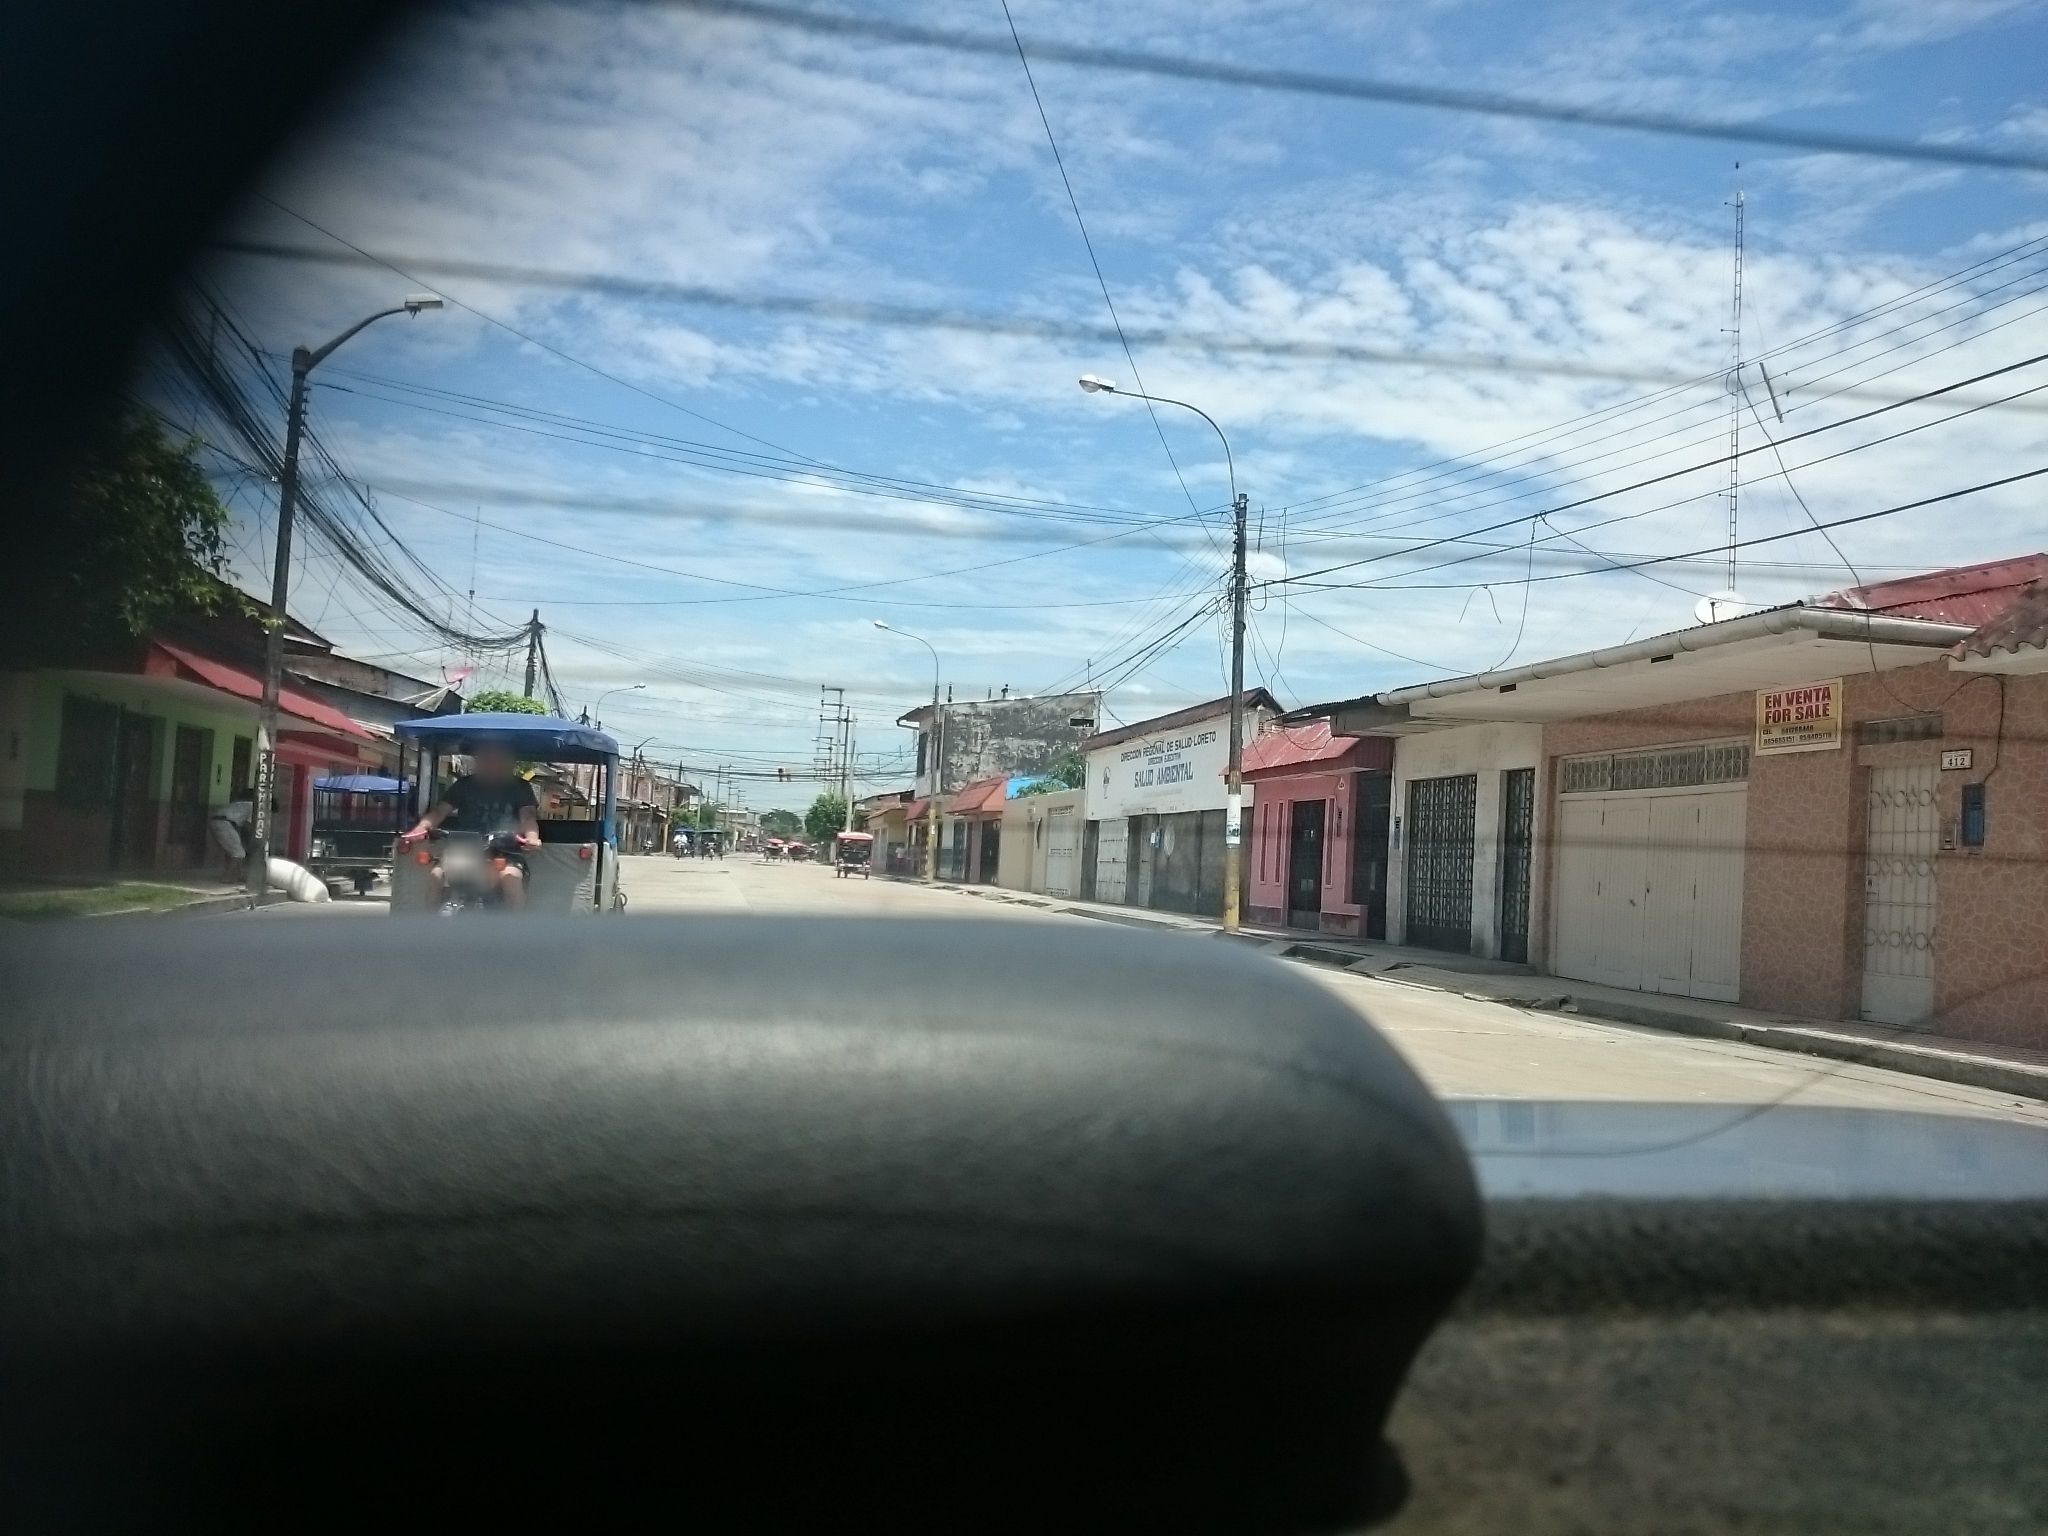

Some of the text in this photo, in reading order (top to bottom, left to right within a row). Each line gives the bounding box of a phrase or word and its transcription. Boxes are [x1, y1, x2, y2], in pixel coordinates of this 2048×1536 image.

[1765, 686, 1832, 710] EN VENTA
[1764, 703, 1830, 724] FOR SALE
[1142, 743, 1165, 758] REGIONAL
[1166, 741, 1174, 752] DE
[1175, 736, 1193, 749] SALUD
[1193, 731, 1217, 746] LORETO
[1947, 757, 1965, 767] 412
[1134, 761, 1194, 788] SALUD AMBIENTAL
